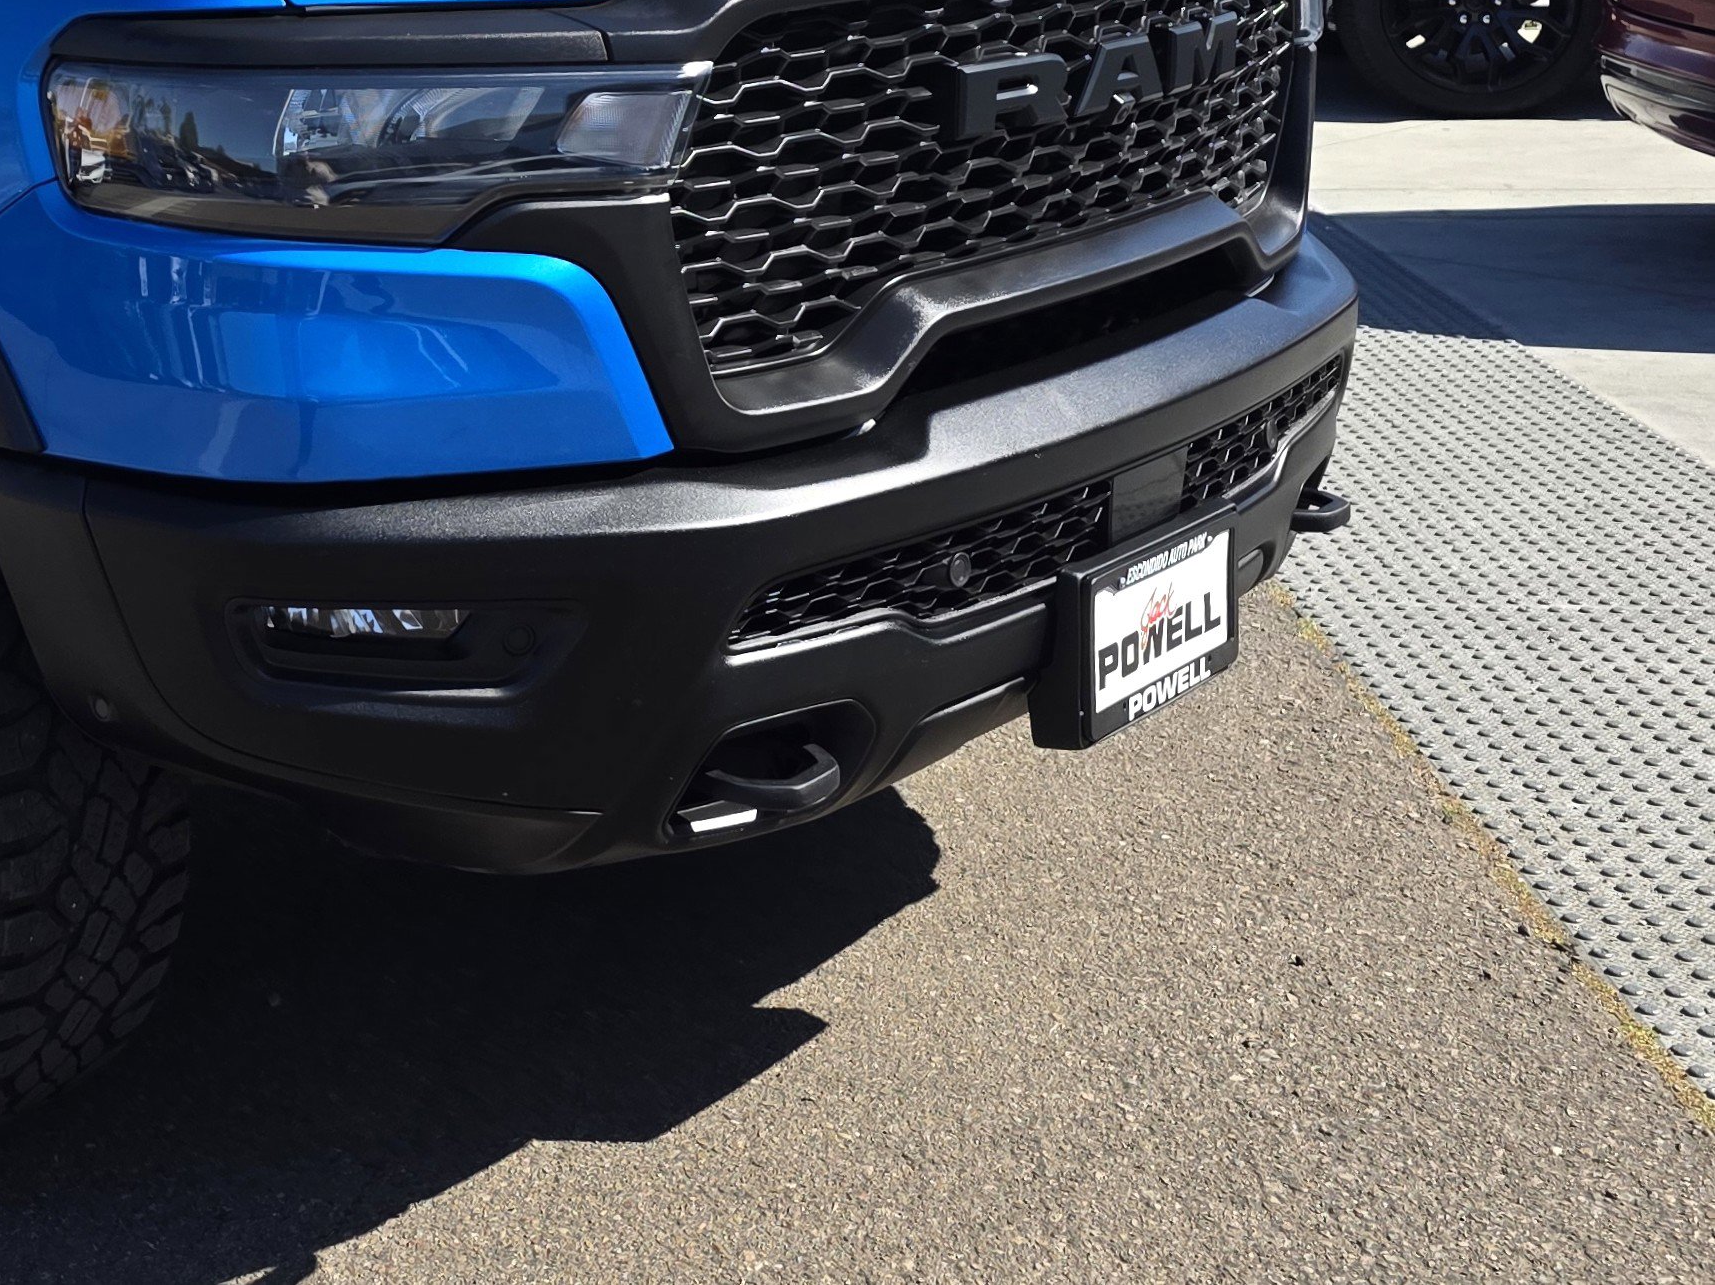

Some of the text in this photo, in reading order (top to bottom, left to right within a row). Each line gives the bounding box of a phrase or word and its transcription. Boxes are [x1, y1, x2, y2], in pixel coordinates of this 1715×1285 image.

[955, 11, 1237, 140] RAM
[1126, 532, 1208, 585] ESCONDIDO AUTO PARK
[1098, 592, 1221, 691] POWELL
[1141, 582, 1176, 649] Jack
[1128, 656, 1211, 721] POWELL
